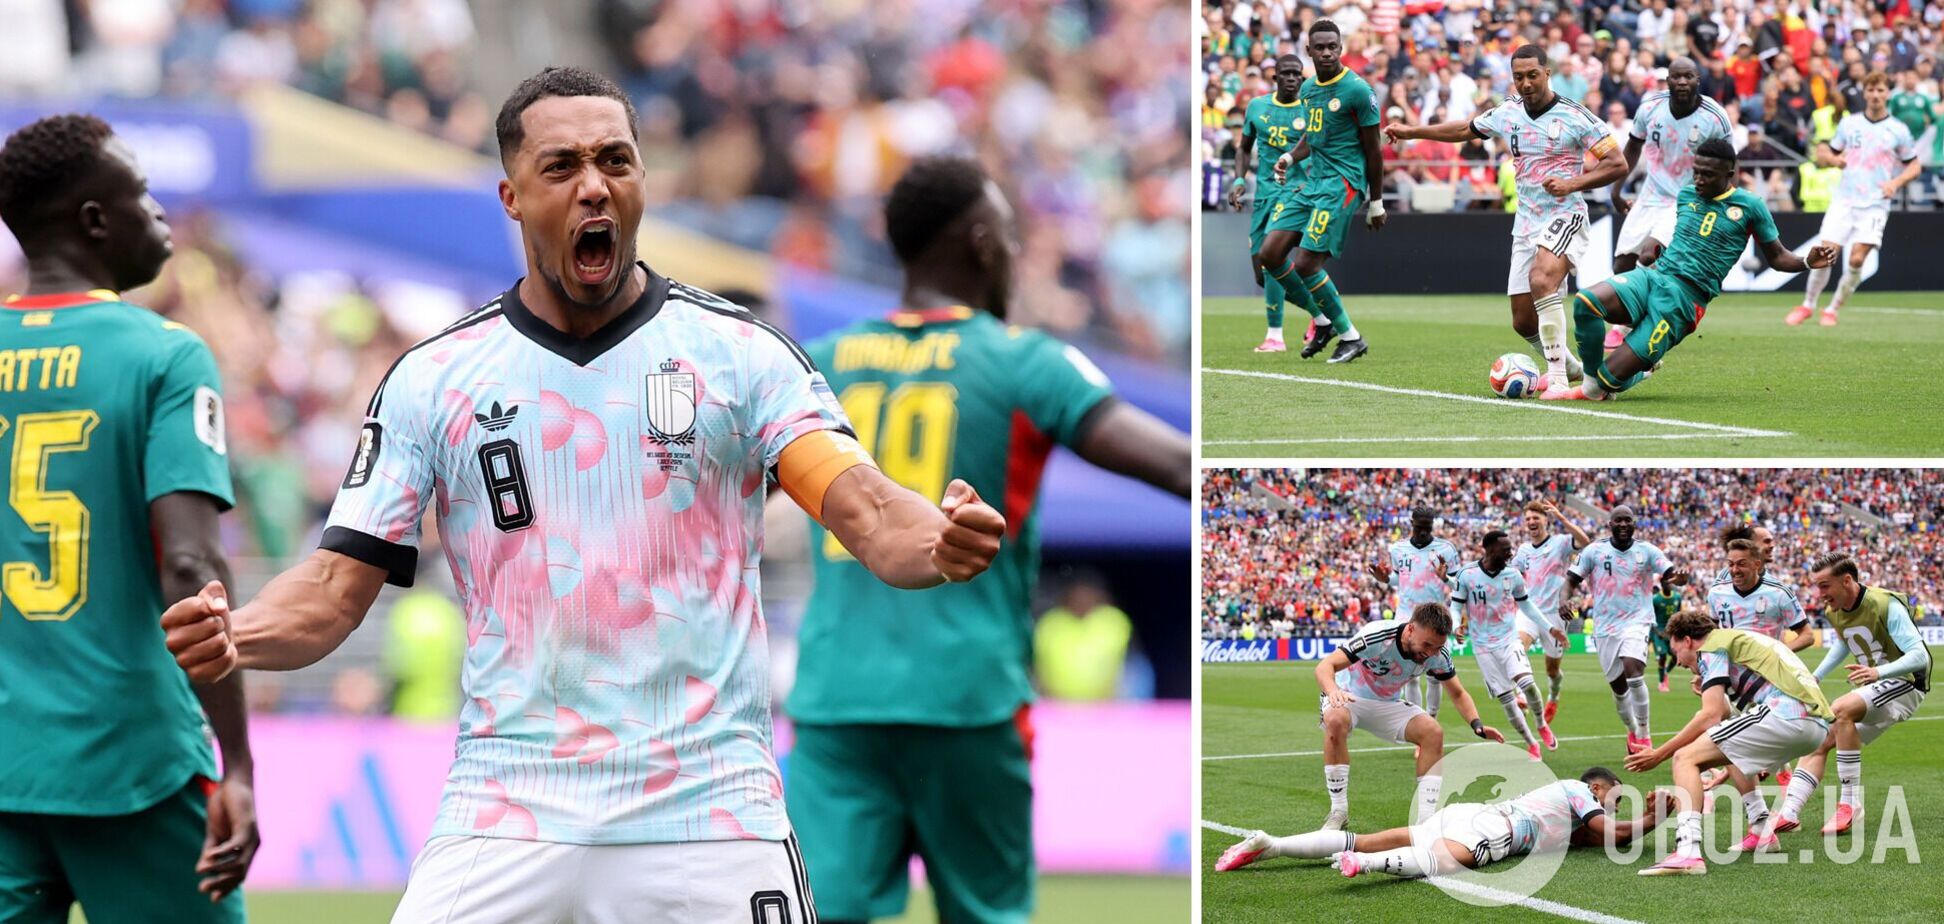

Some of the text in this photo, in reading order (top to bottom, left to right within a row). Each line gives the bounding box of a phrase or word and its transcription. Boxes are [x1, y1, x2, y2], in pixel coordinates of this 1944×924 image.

[1306, 107, 1323, 132] 19
[1268, 125, 1290, 147] 25
[1510, 134, 1521, 157] 8
[1651, 131, 1661, 149] 9
[1307, 208, 1330, 235] 19
[1548, 218, 1566, 235] 8
[1699, 211, 1718, 237] 8
[1650, 319, 1670, 344] 8
[477, 438, 537, 534] 8
[0, 409, 100, 621] 5
[1398, 559, 1412, 572] 24
[1604, 561, 1612, 576] 9
[1472, 590, 1487, 605] 14
[1718, 610, 1734, 629] 21
[1201, 640, 1271, 662] Michelob
